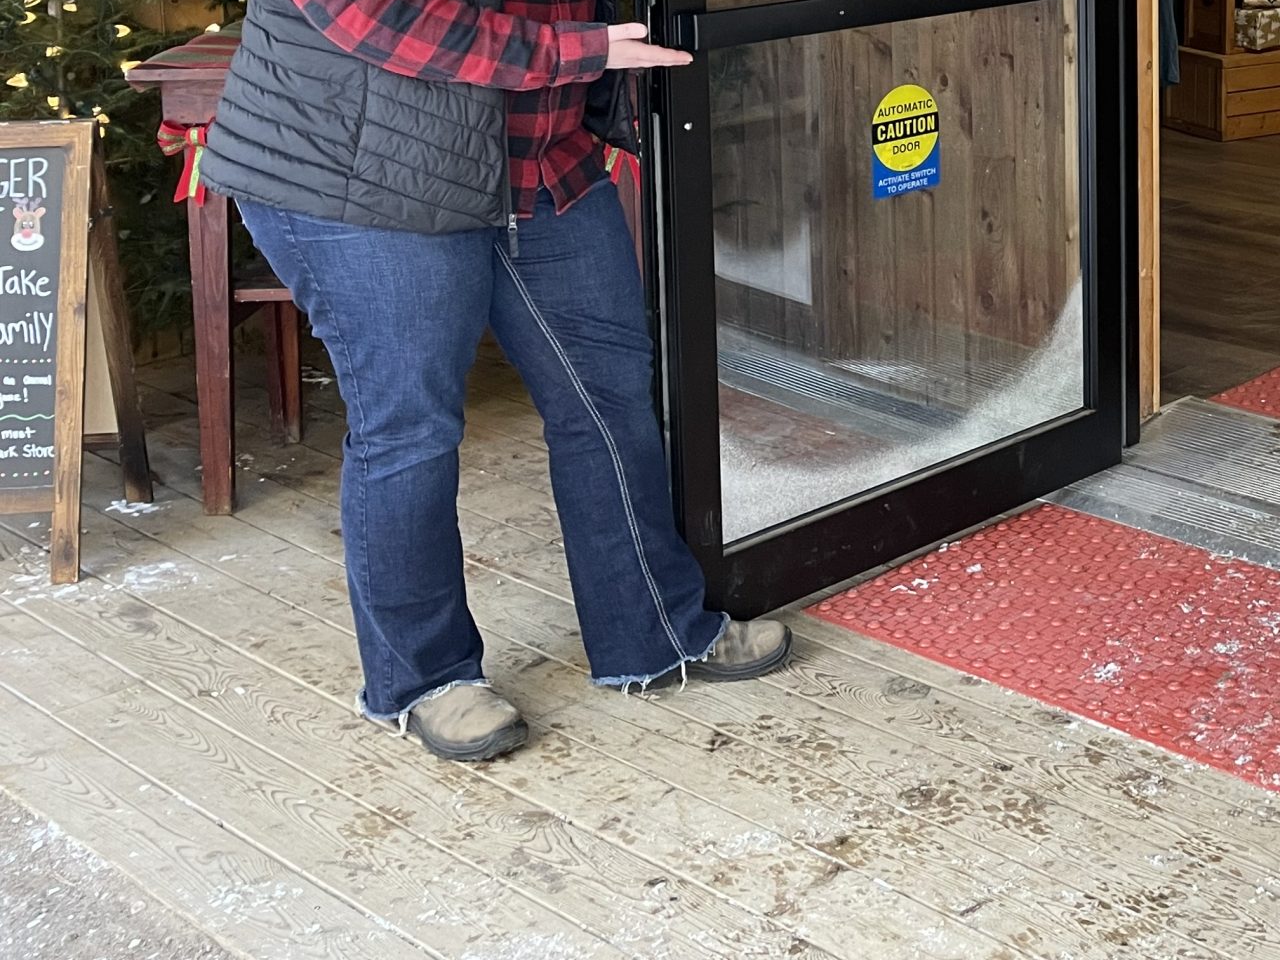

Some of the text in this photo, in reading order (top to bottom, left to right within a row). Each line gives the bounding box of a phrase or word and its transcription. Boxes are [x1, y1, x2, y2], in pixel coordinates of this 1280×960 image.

[877, 99, 933, 118] AUTOMATIC
[877, 115, 935, 141] CAUTION
[892, 140, 920, 155] DOOR
[878, 167, 936, 187] ACTIVATE SWITCH
[887, 178, 928, 193] TO OPERATE
